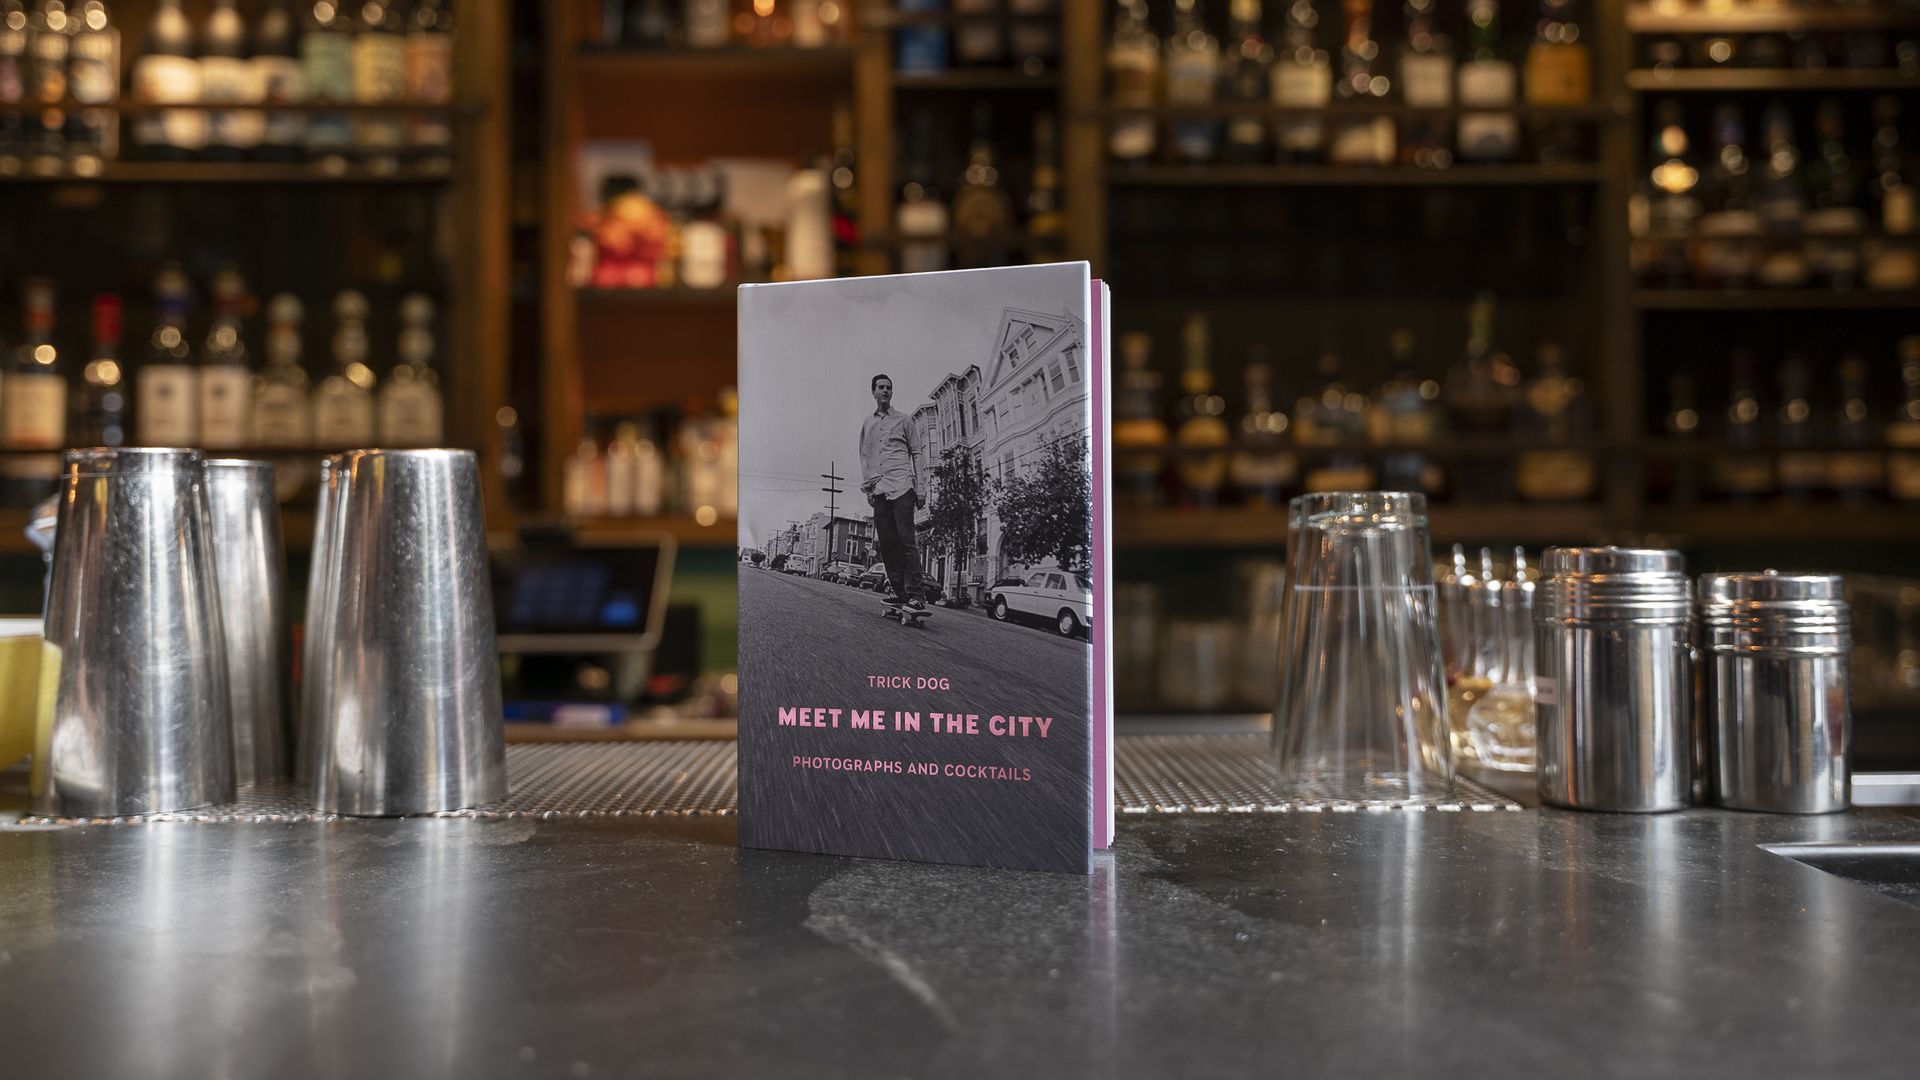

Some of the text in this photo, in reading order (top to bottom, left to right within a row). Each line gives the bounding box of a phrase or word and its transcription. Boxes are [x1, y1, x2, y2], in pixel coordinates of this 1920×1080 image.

[868, 675, 950, 691] TRICK DOG
[778, 706, 1054, 738] MEET ME IN THE CITY
[792, 755, 1032, 782] PHOTOGRAPHS AND COCKTAILS
